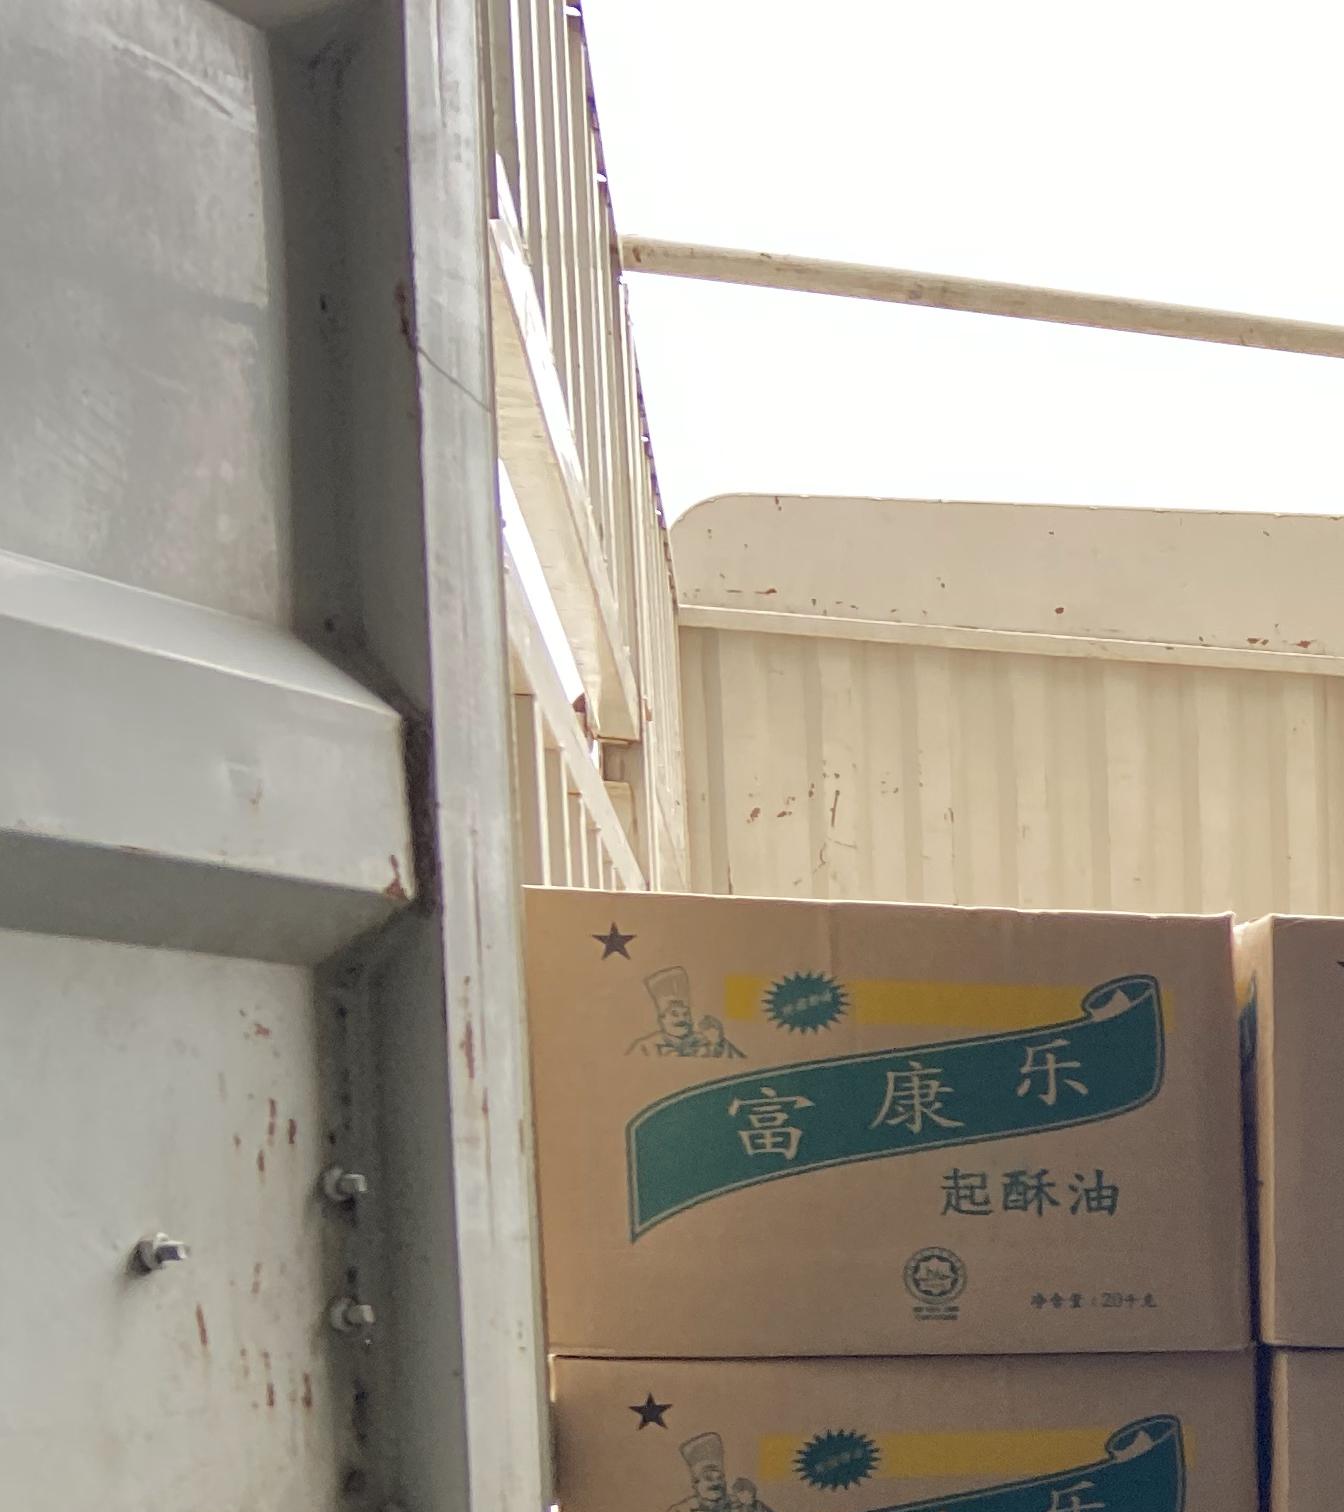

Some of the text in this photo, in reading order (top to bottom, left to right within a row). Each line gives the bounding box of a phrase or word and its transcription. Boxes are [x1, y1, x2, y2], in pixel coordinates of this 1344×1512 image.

[727, 1040, 1088, 1159] 富康乐
[940, 1169, 1119, 1216] 起酥油
